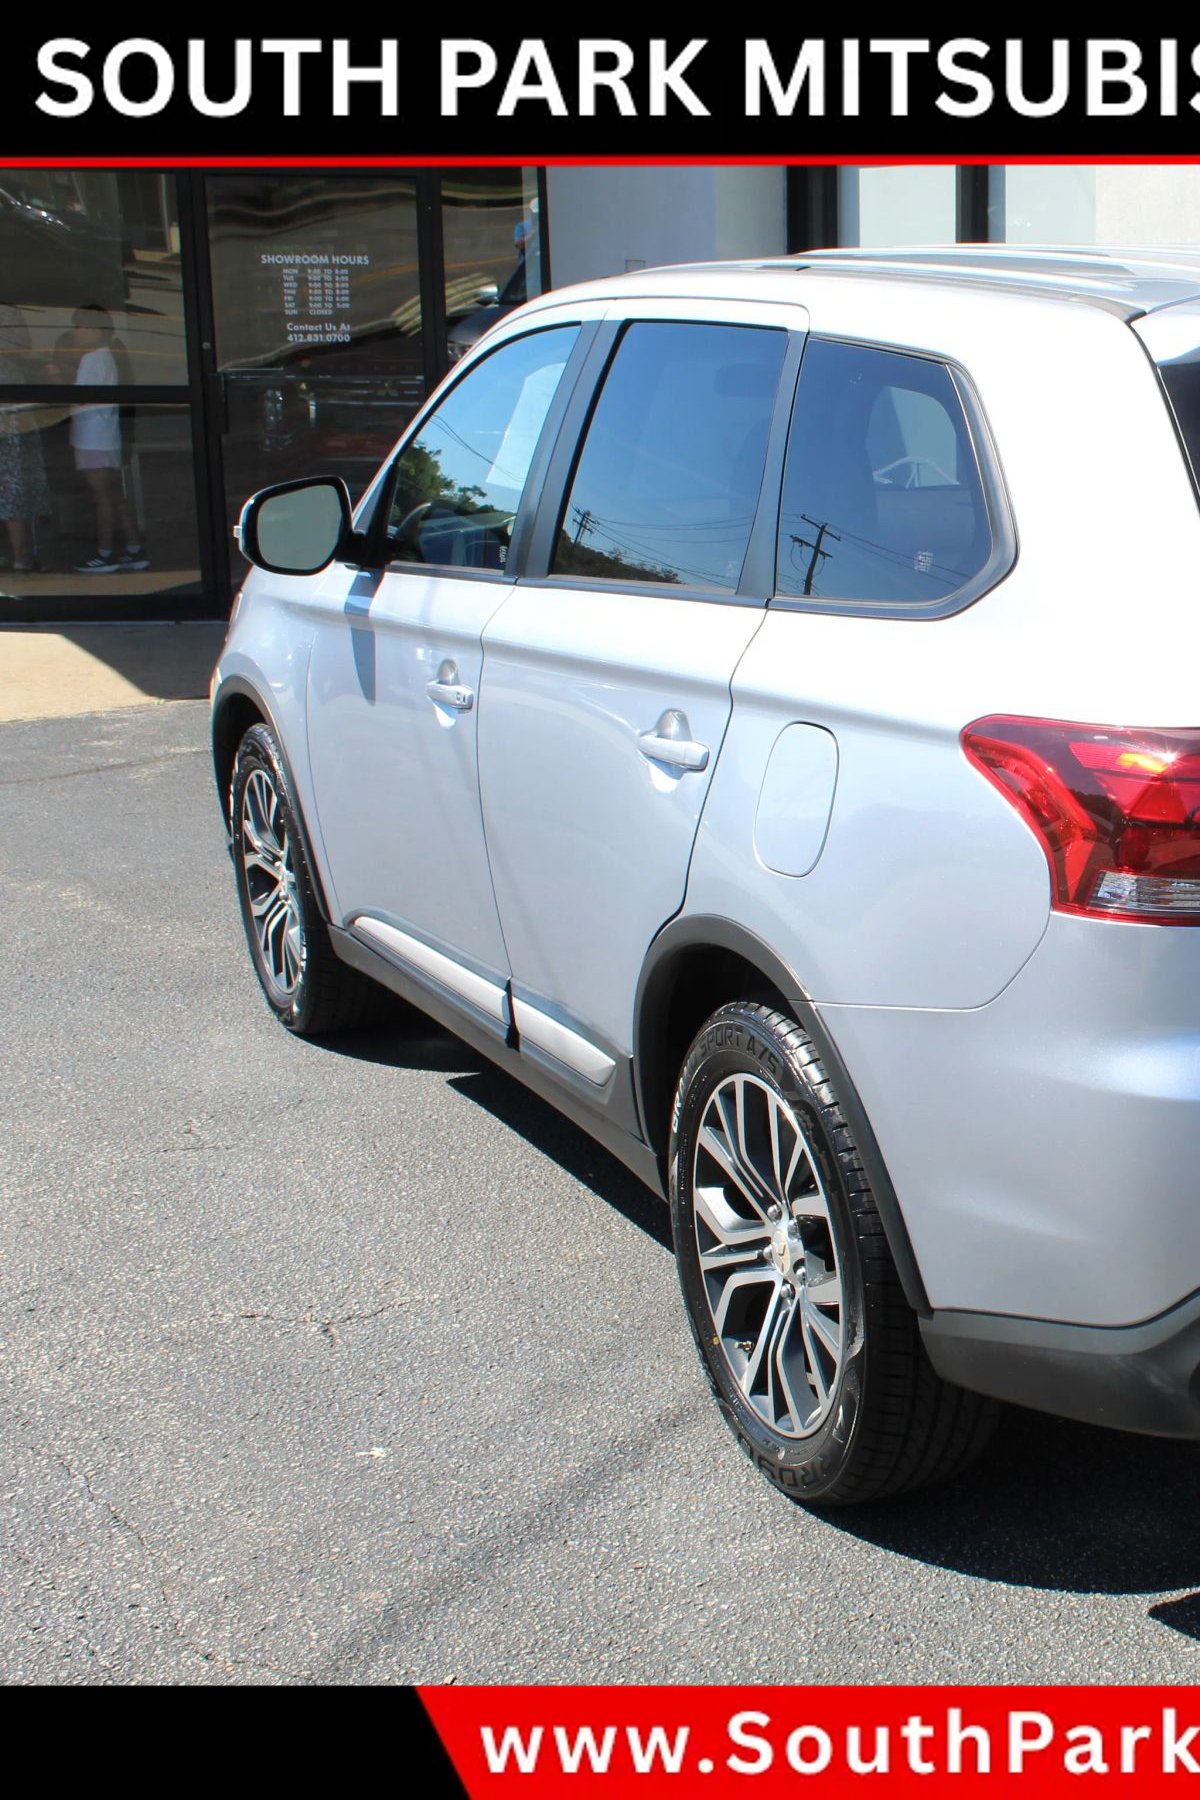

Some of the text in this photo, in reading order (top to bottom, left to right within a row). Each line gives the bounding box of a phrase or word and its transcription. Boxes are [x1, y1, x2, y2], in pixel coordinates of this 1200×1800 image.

[260, 254, 369, 265] SHOWROOM HOURS
[286, 322, 350, 331] Contact Us At
[287, 333, 351, 343] 412.831.0700
[700, 1026, 743, 1057] SPORT
